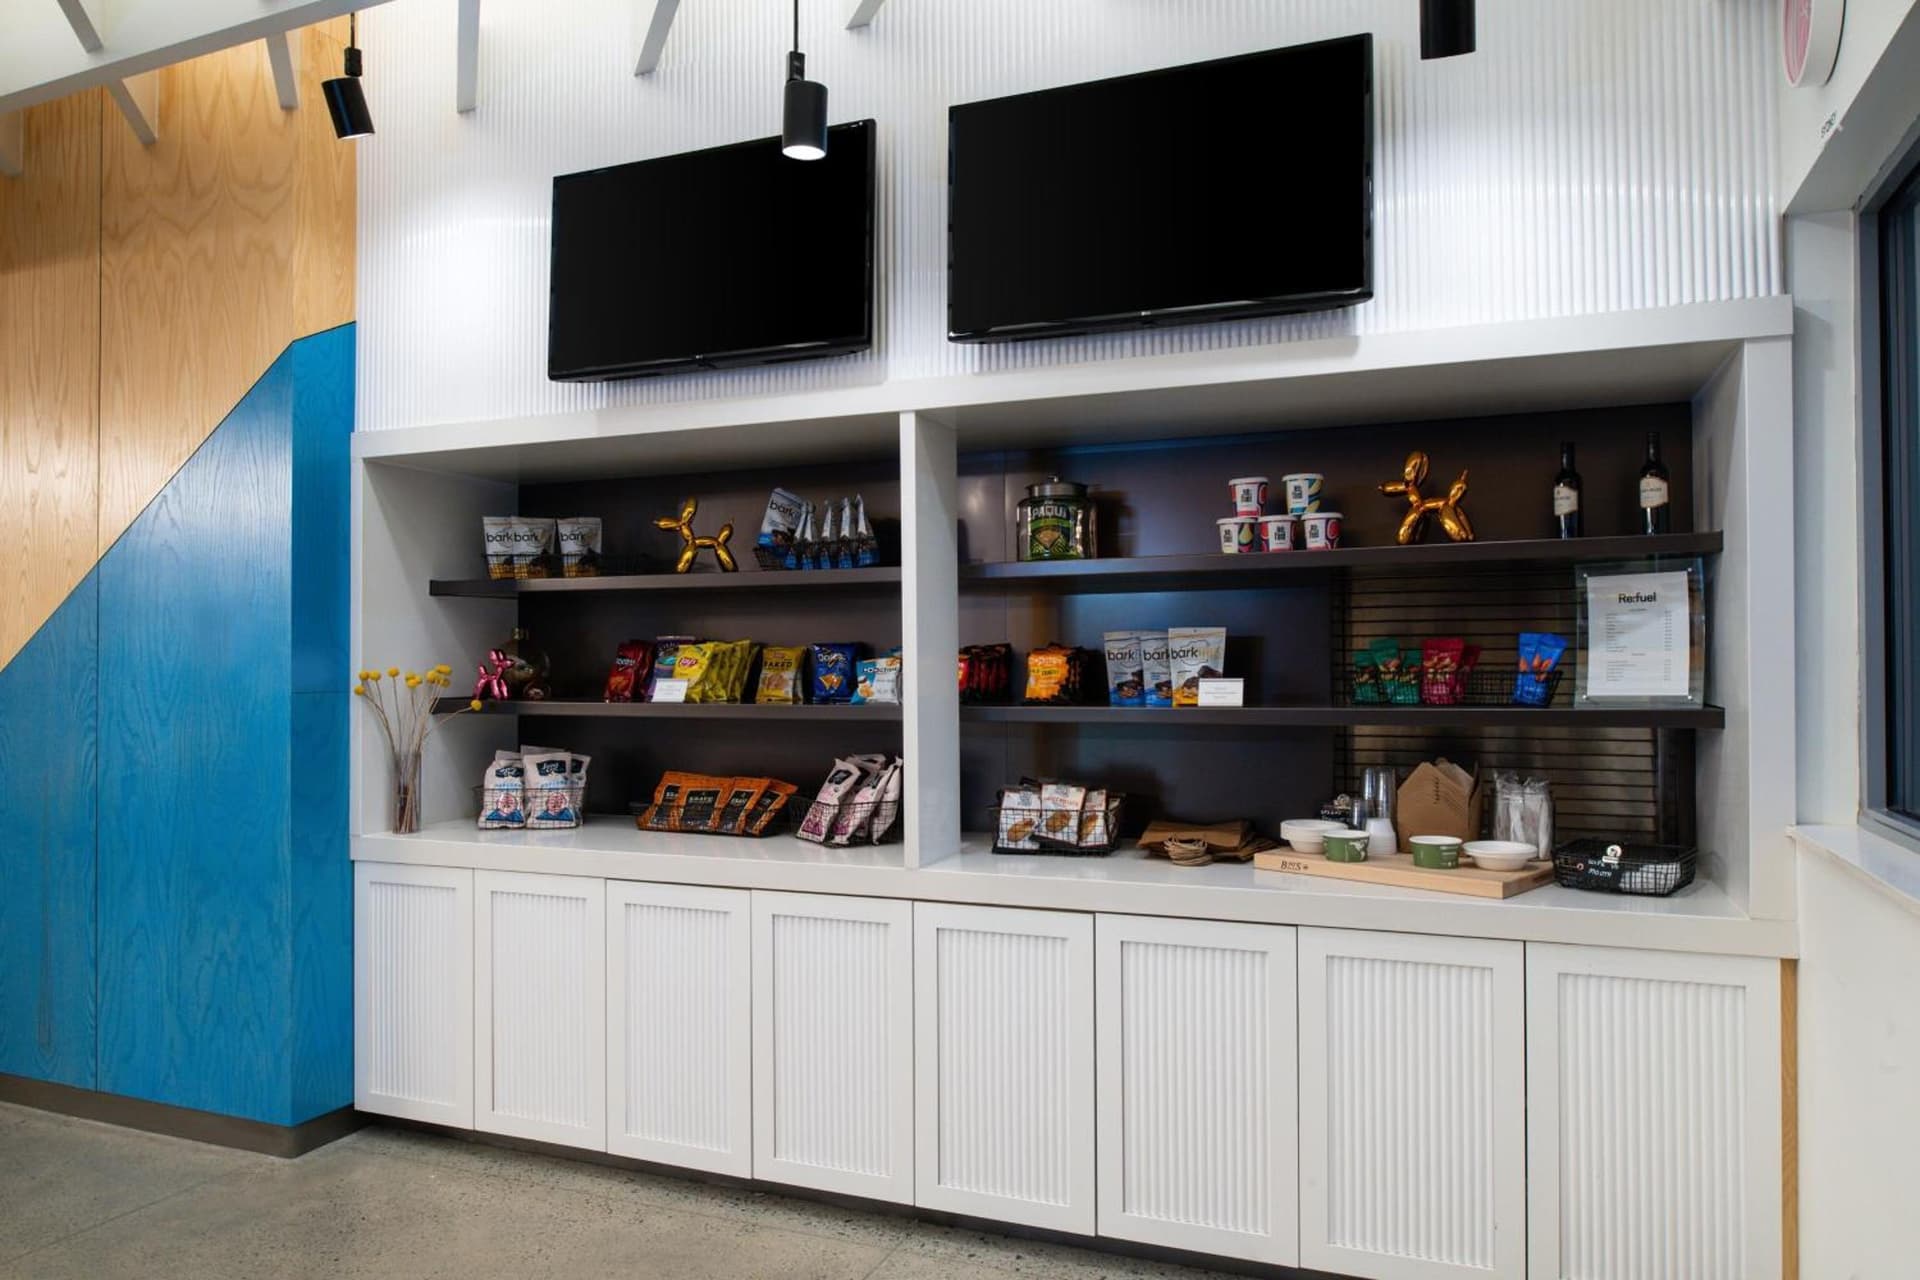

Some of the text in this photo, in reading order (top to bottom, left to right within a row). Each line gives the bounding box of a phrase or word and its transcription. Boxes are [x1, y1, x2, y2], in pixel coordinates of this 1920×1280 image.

[487, 532, 513, 543] bark
[1618, 592, 1657, 604] Re:fuel
[1107, 649, 1136, 661] bark
